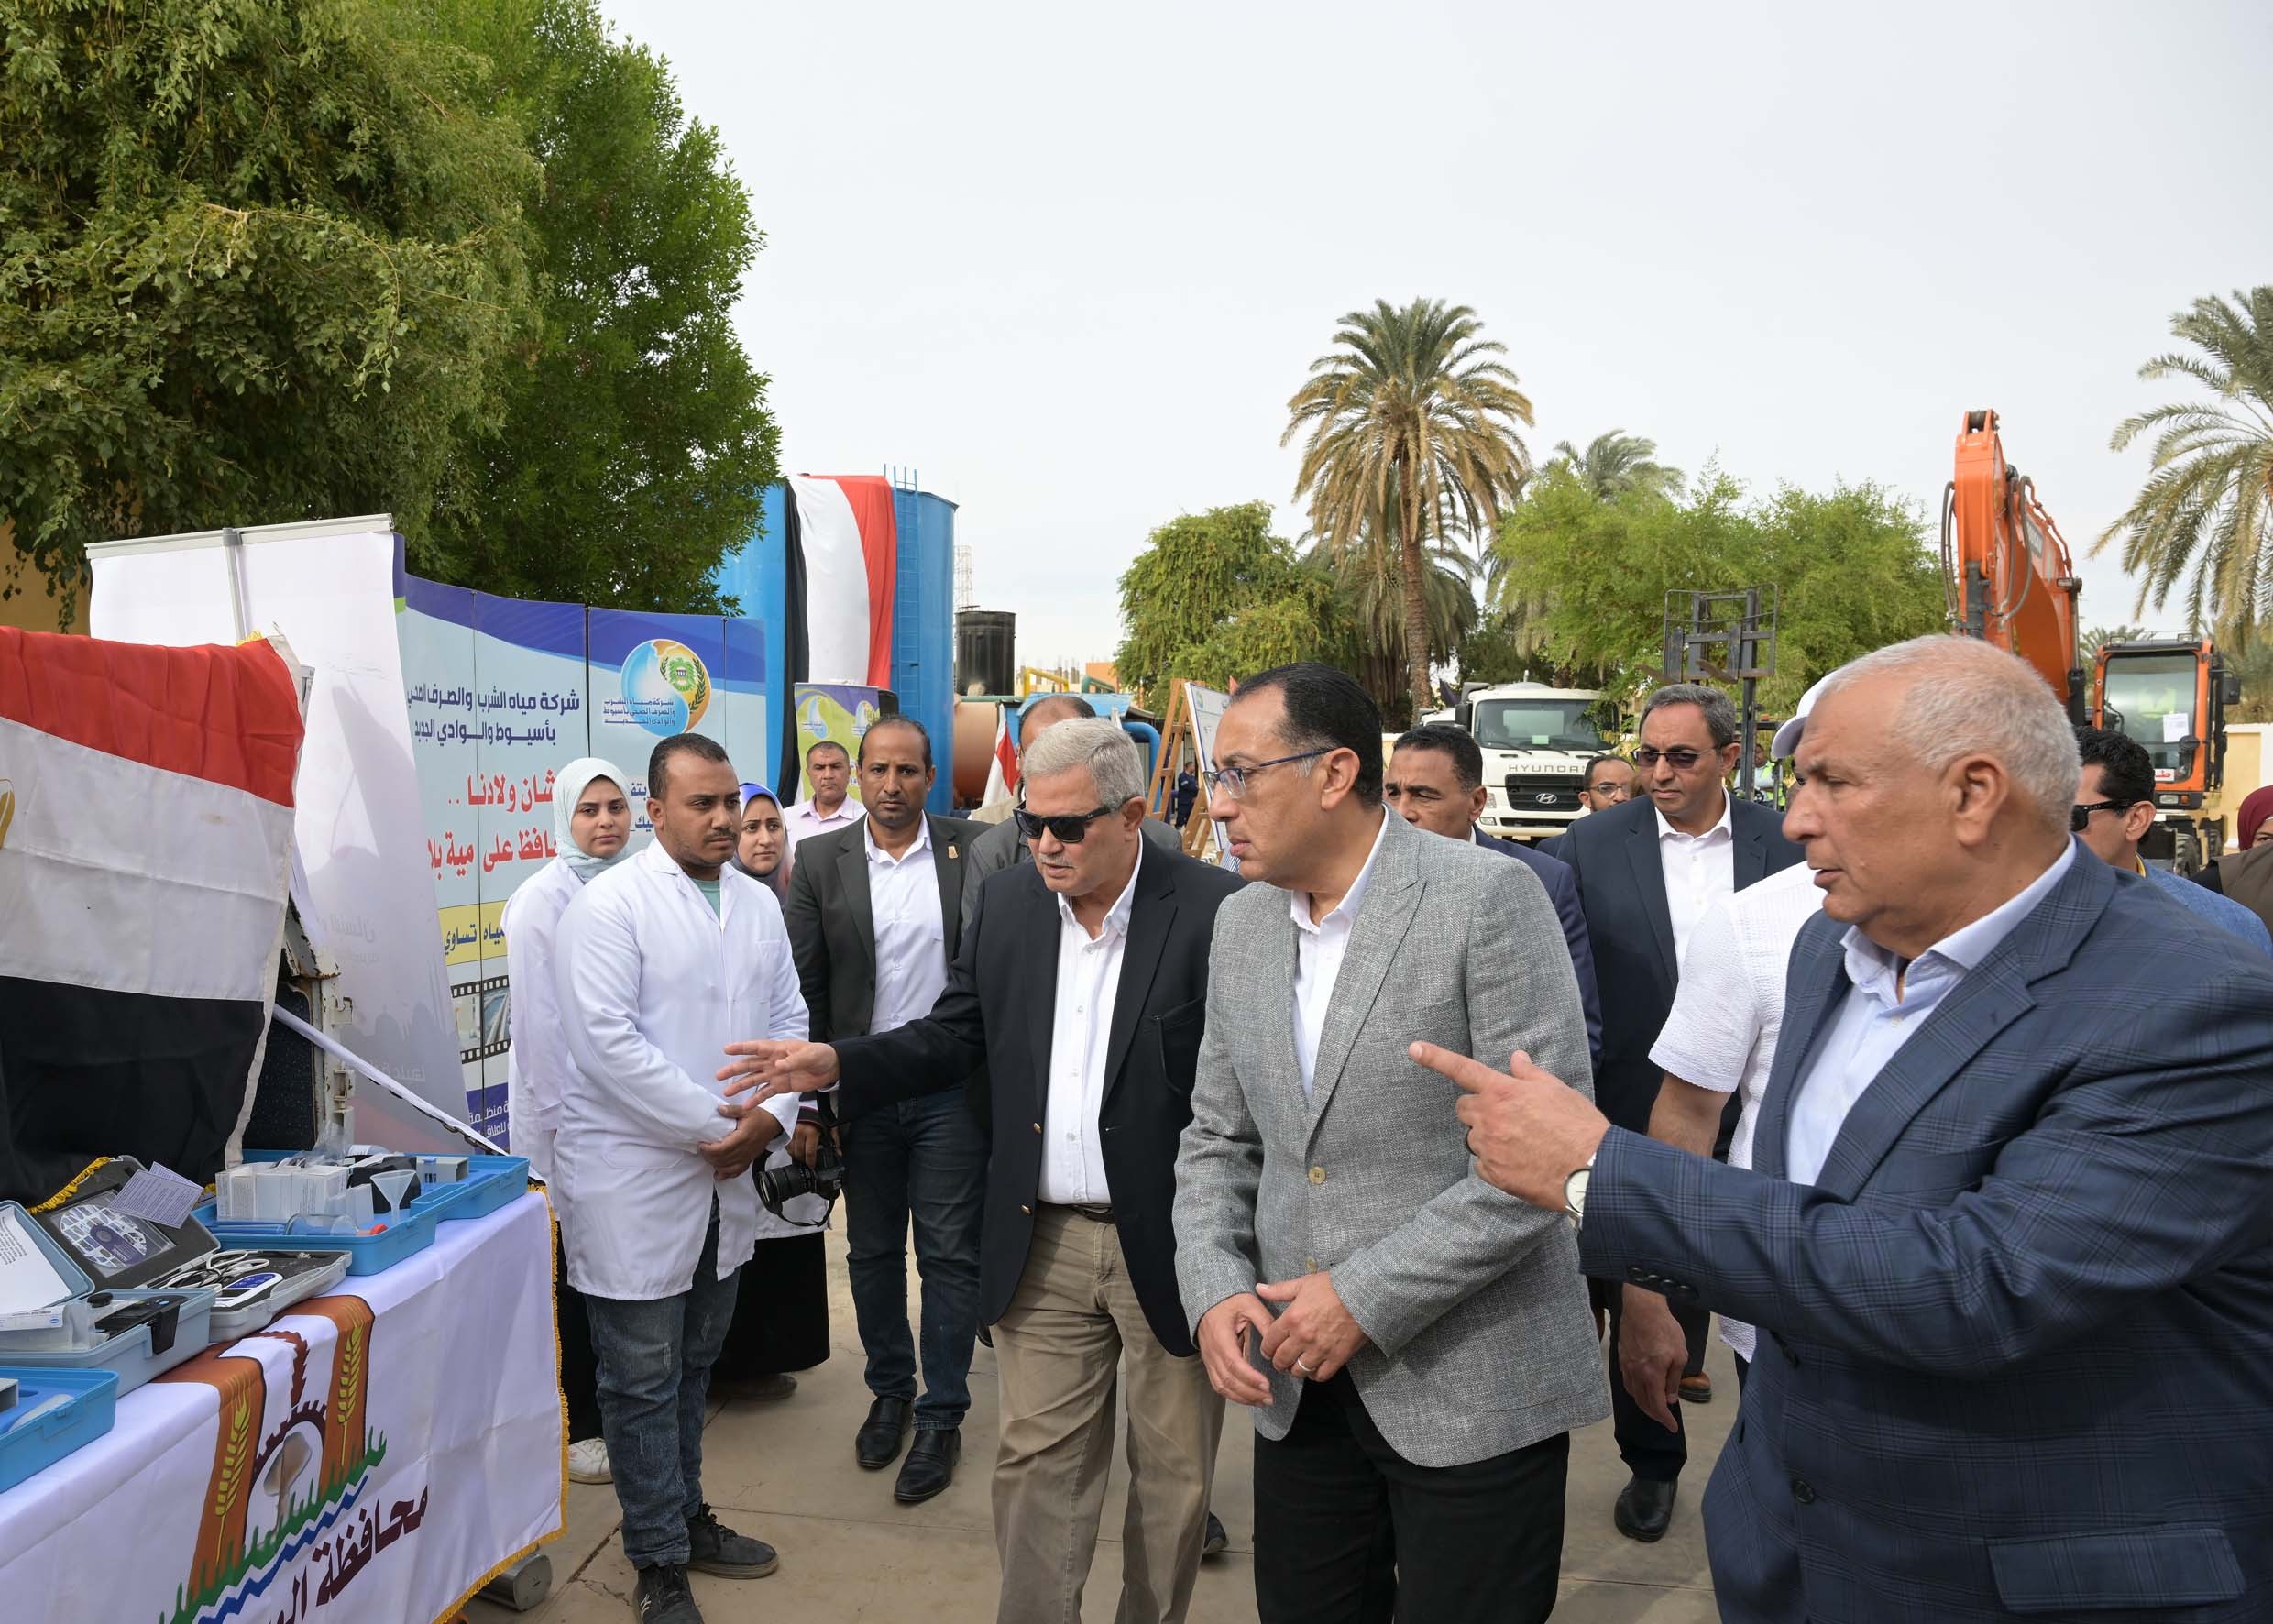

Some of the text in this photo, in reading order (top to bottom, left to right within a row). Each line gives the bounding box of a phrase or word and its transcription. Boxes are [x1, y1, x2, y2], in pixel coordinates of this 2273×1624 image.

[427, 683, 473, 711] والصرف
[478, 685, 506, 714] الشرب
[509, 692, 536, 715] مياه
[540, 689, 580, 716] شركة
[437, 719, 493, 747] والوادي
[495, 719, 556, 746] بأسيوط
[467, 773, 516, 813] ولادنا
[521, 768, 555, 812] شان
[446, 831, 474, 876] مية
[483, 832, 514, 872] على
[518, 827, 558, 860] افظ
[444, 924, 477, 955] تساوي
[312, 1485, 428, 1607] محافظة
